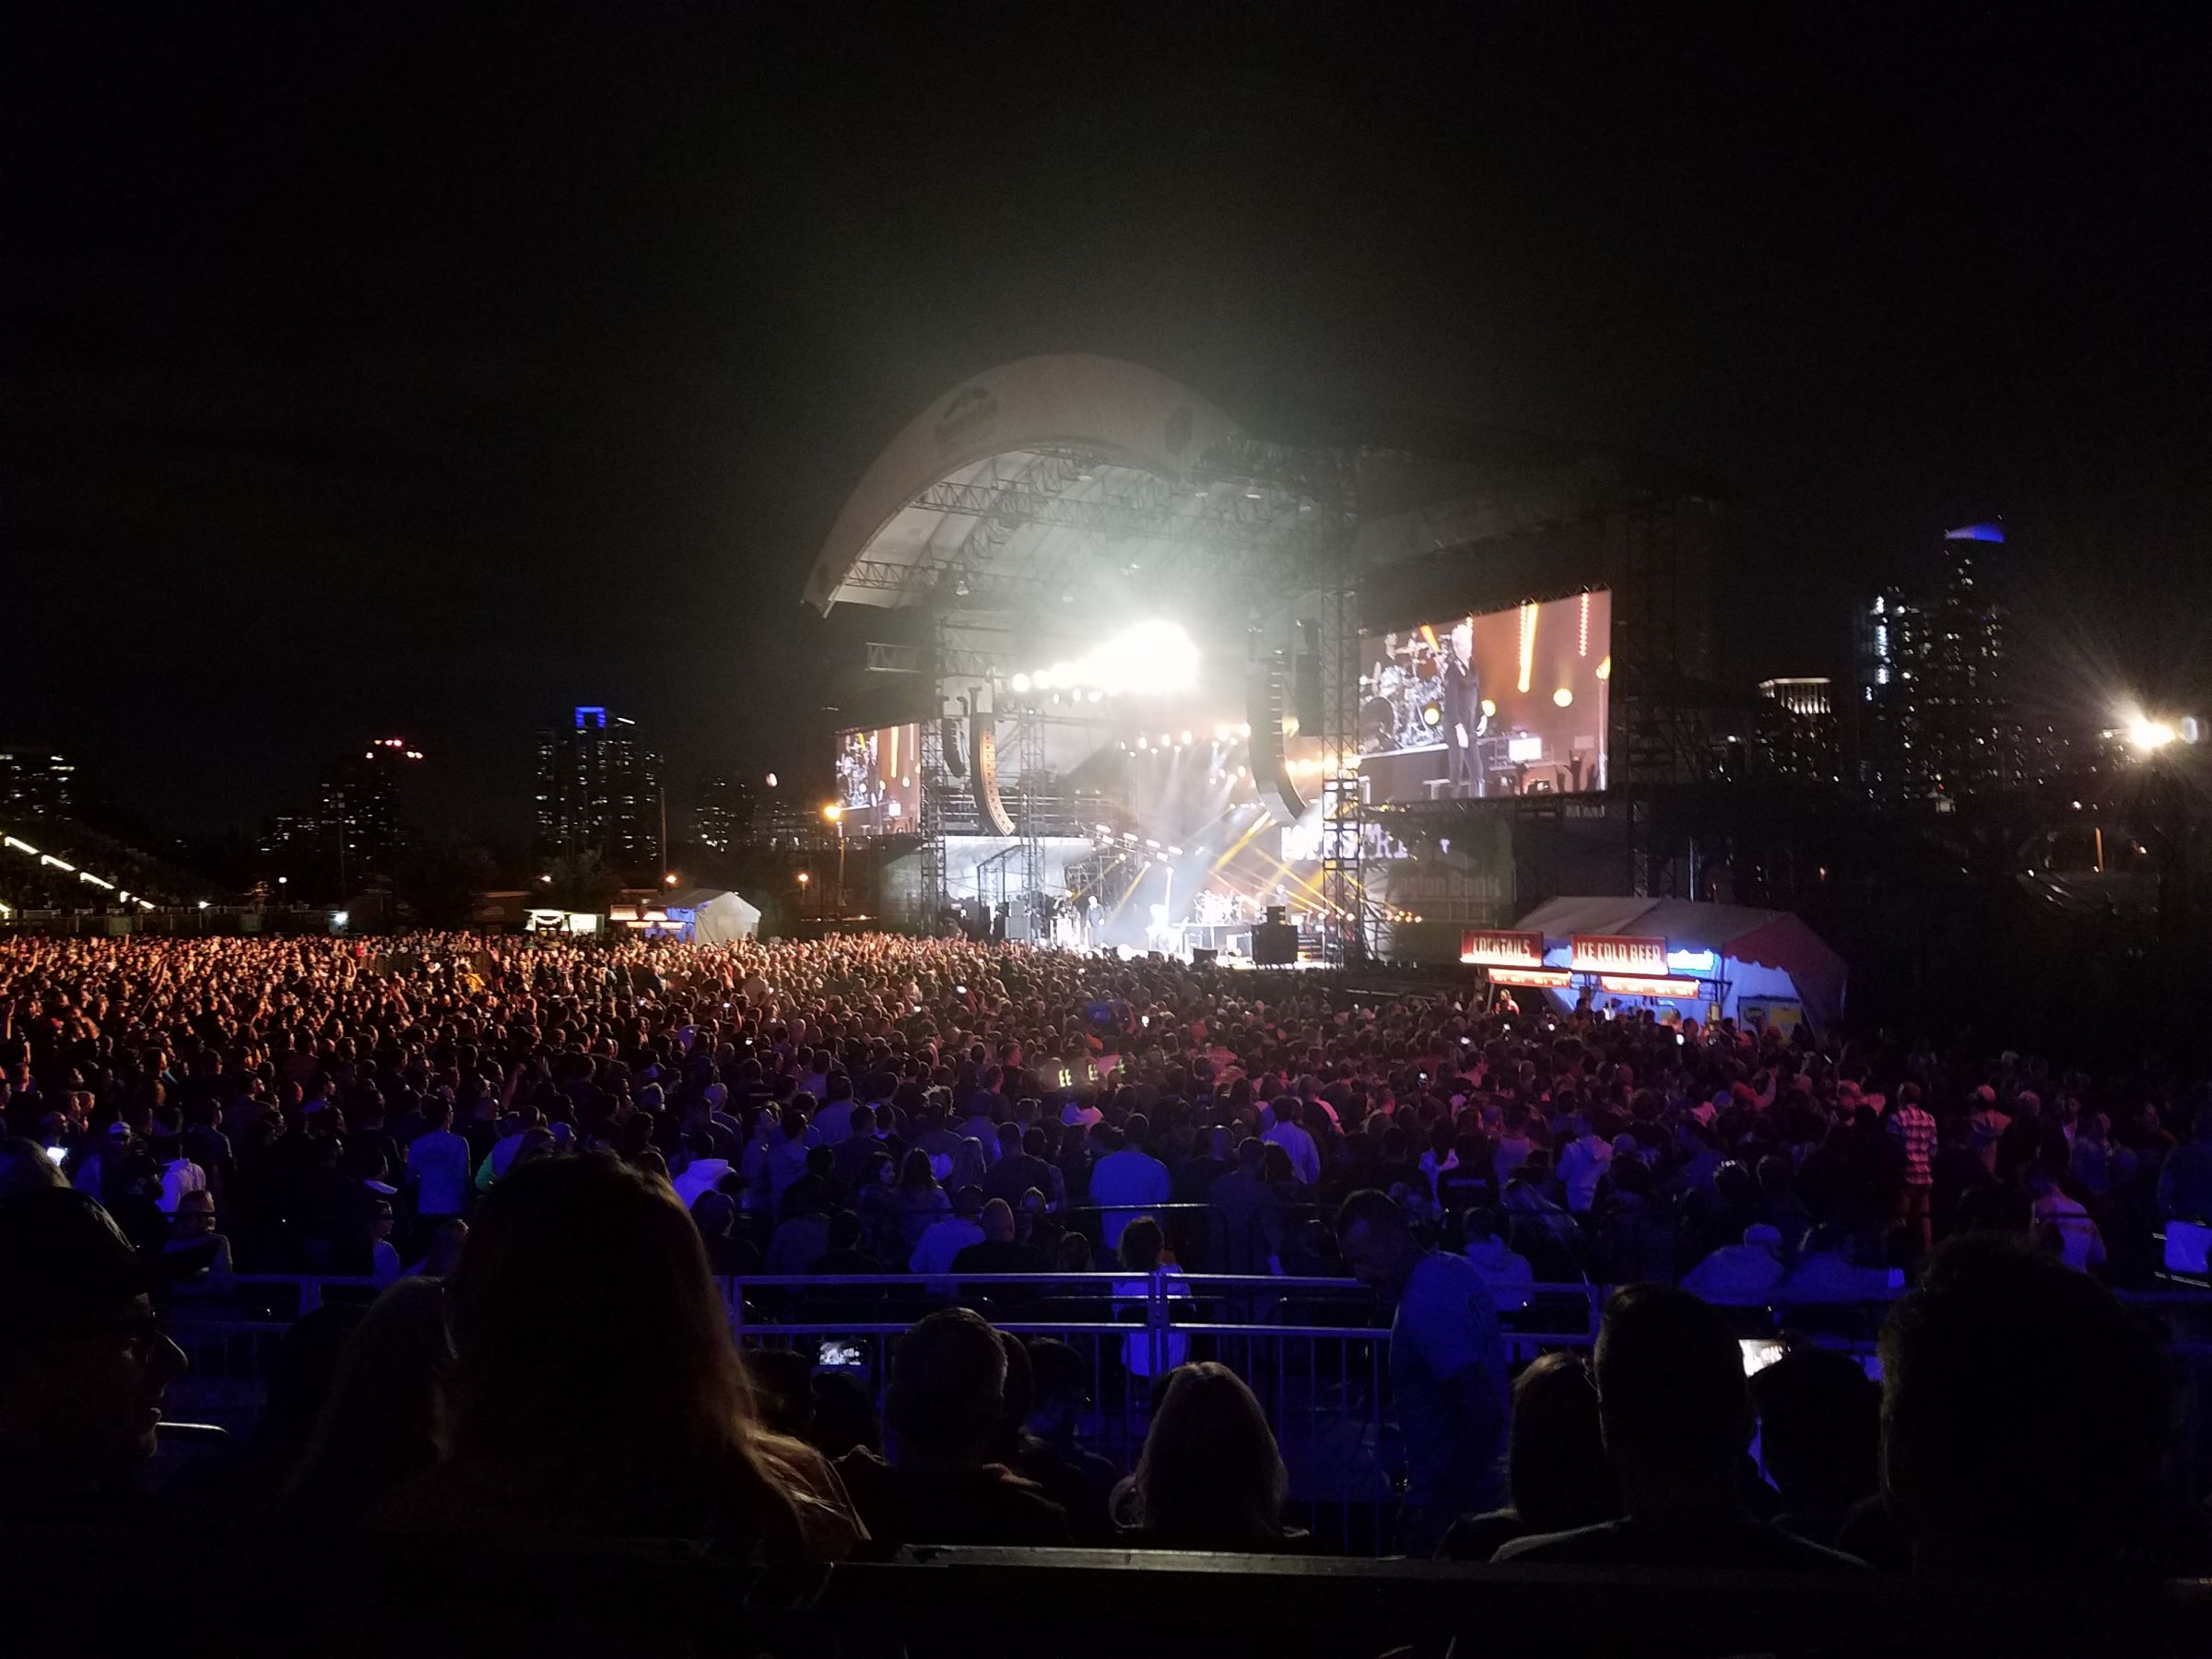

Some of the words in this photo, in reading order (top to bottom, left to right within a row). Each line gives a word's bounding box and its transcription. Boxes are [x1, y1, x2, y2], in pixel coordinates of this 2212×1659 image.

[1474, 936, 1532, 958] COCKTAILS
[1577, 942, 1595, 961] ICE
[1597, 943, 1626, 964] COLD
[1630, 944, 1663, 966] BEER
